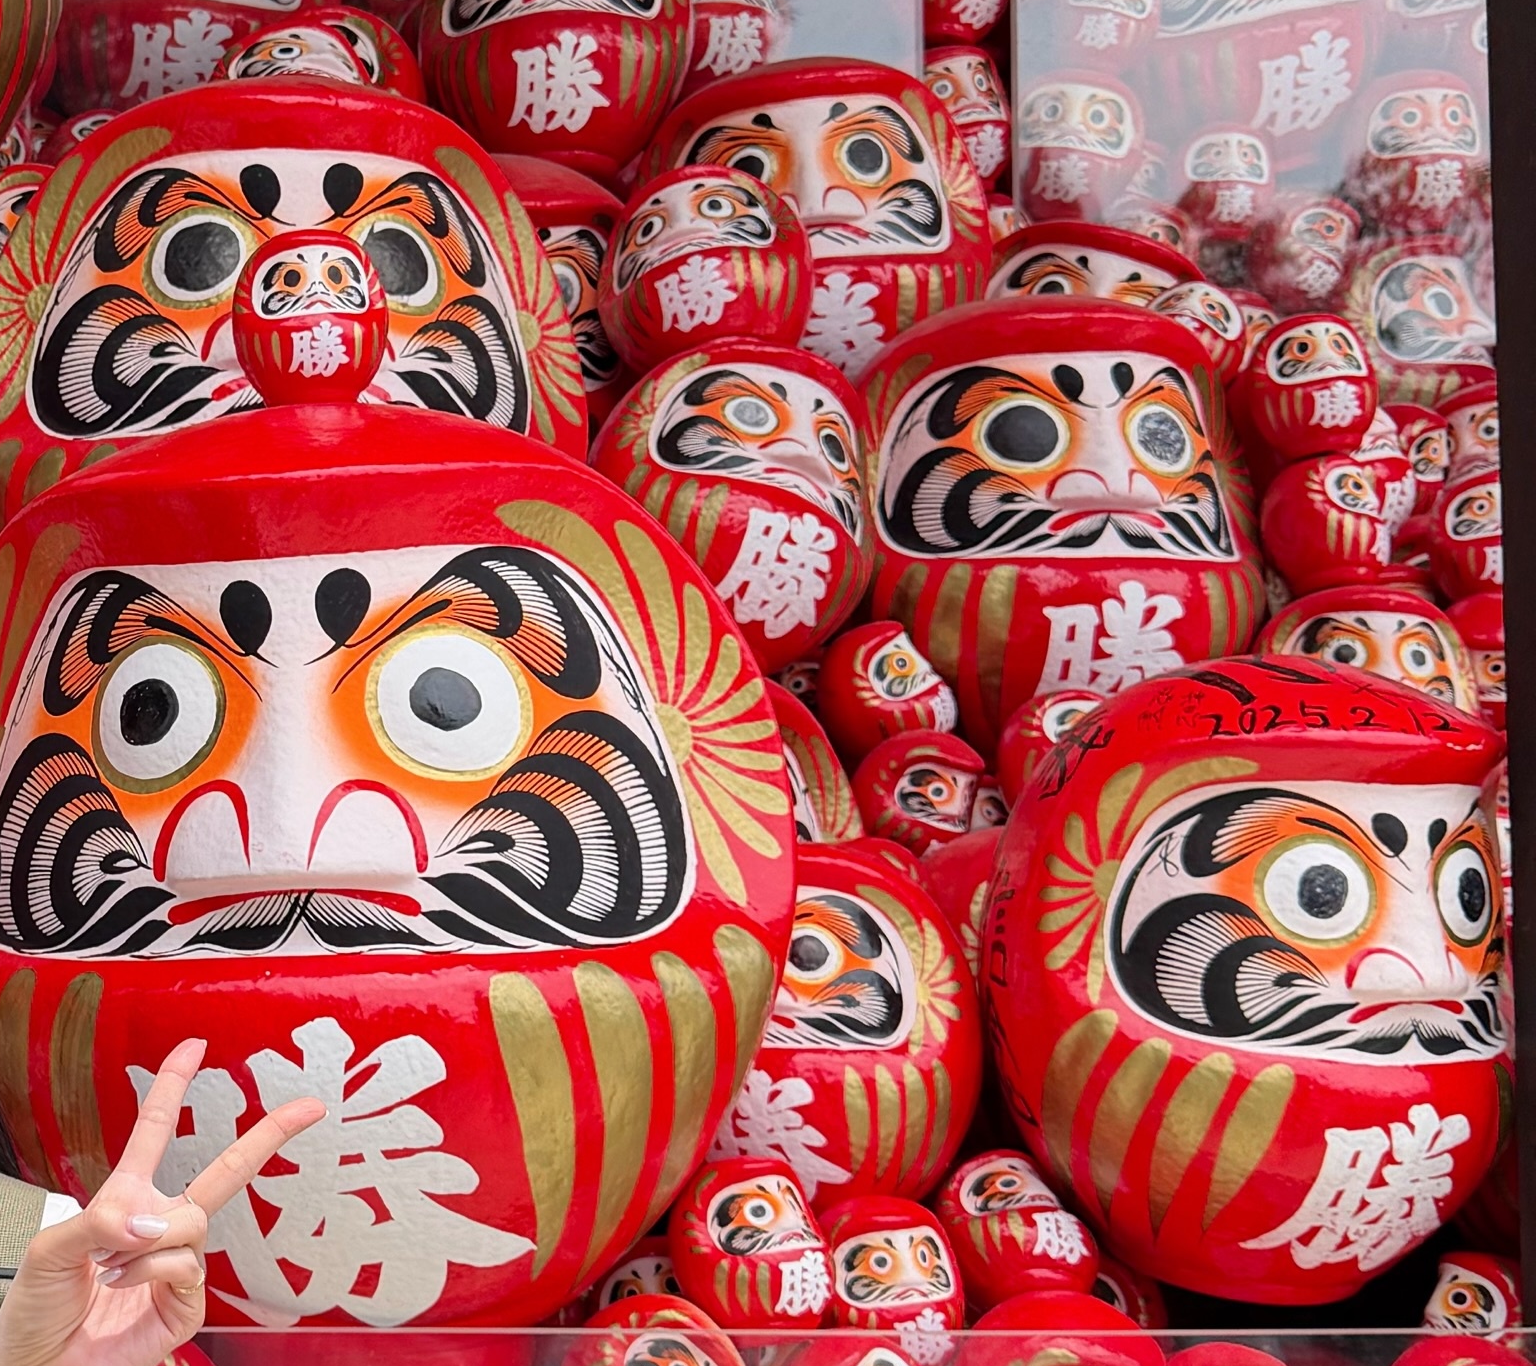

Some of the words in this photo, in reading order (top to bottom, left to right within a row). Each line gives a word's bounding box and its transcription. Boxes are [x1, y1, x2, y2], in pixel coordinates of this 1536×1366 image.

[120, 9, 233, 99] 勝
[698, 13, 764, 75] 勝
[506, 29, 611, 133] 勝
[1251, 29, 1353, 135] 勝
[1031, 154, 1090, 202] 勝
[1213, 184, 1254, 222] 勝
[1412, 160, 1462, 211] 勝
[654, 254, 738, 333] 勝
[289, 320, 350, 378] 勝
[1313, 381, 1364, 429] 勝
[715, 507, 838, 639] 勝
[1034, 579, 1184, 695] 勝
[1199, 699, 1462, 740] 2025.2.12
[125, 1016, 537, 1328] 勝
[1238, 1102, 1470, 1271] 勝
[1032, 1209, 1090, 1265] 勝
[775, 1250, 831, 1316] 勝
[894, 1307, 955, 1366] 勝
